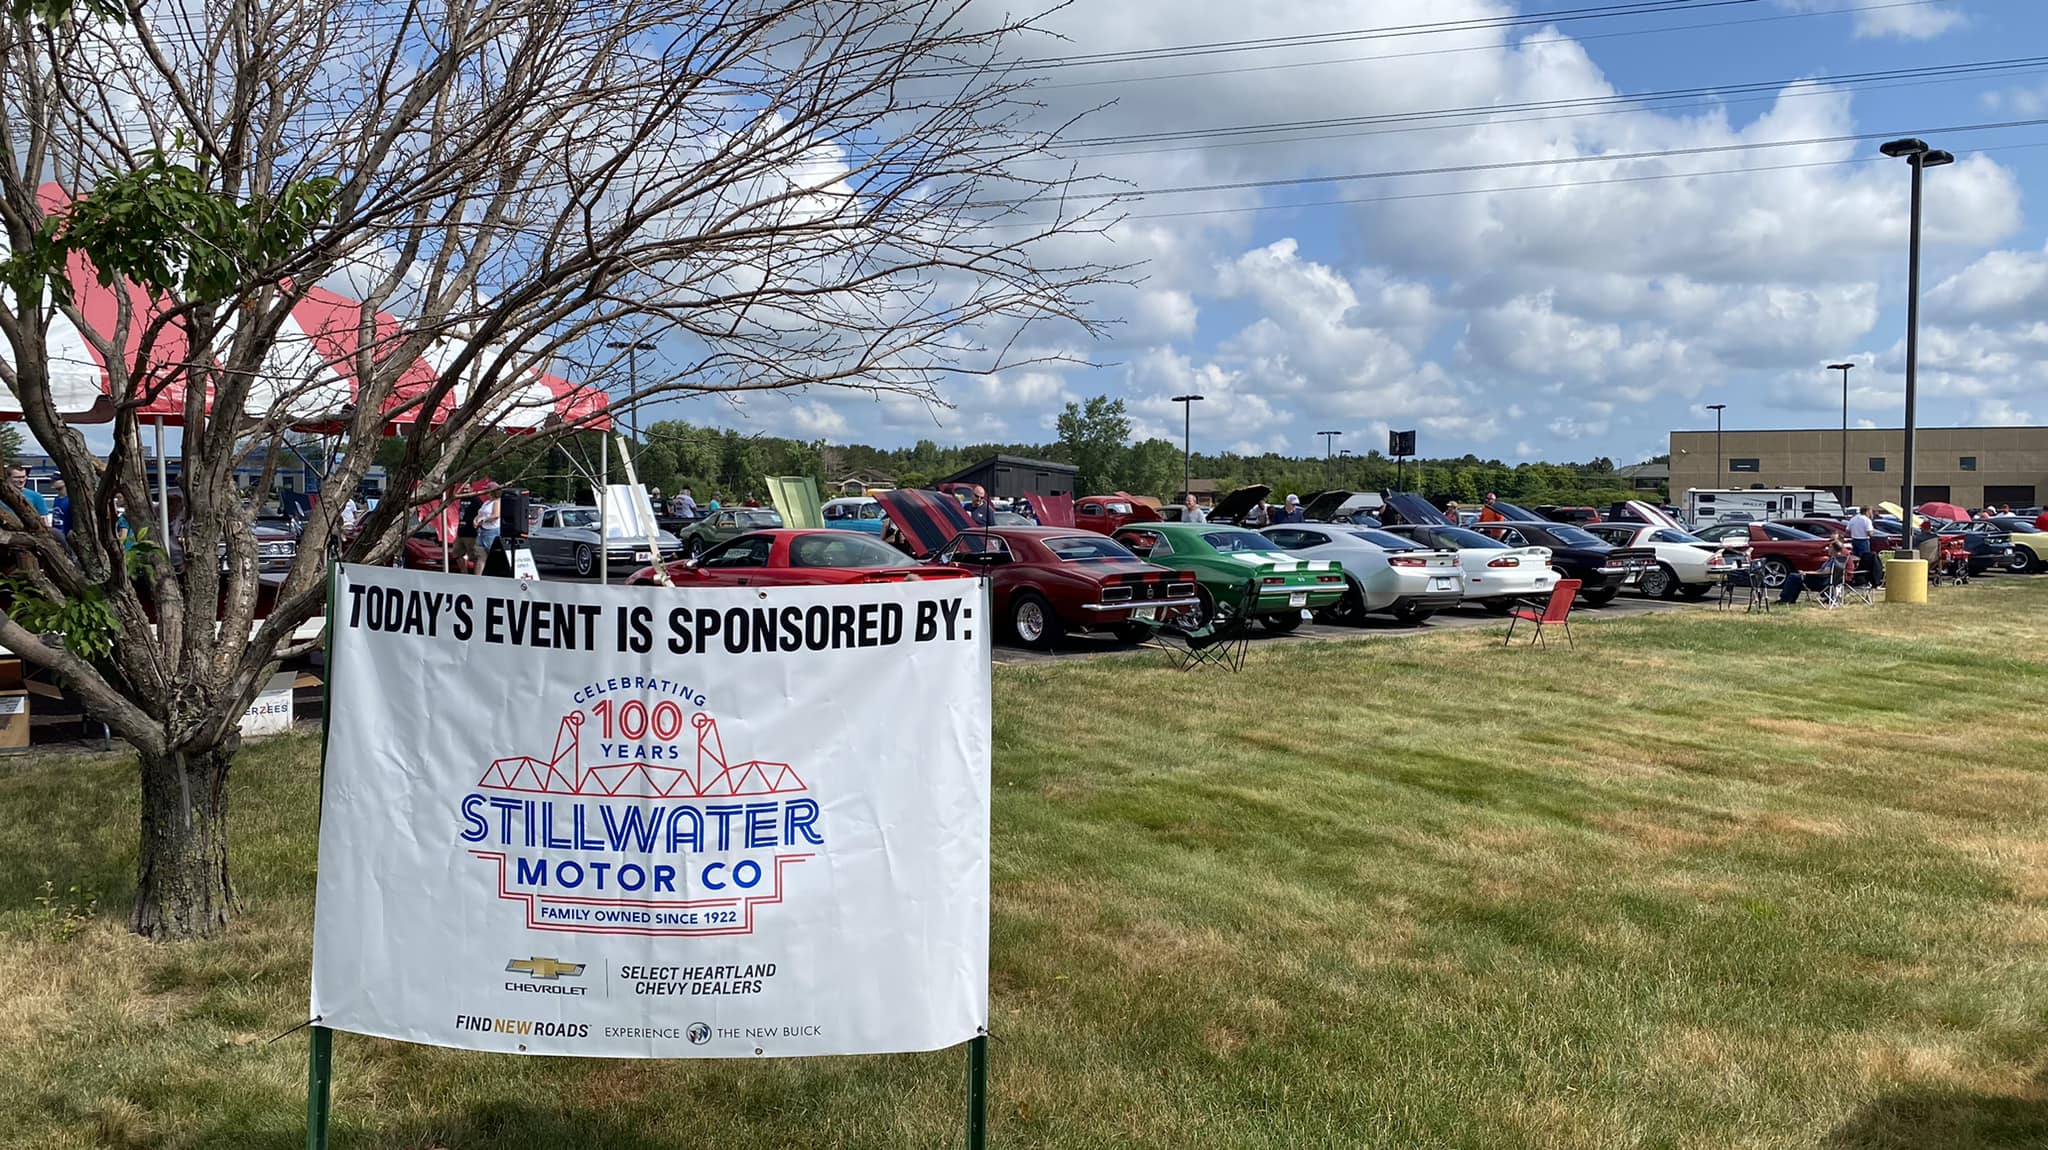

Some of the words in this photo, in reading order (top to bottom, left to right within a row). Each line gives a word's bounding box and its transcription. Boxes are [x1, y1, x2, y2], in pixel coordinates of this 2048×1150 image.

[348, 583, 474, 642] TODAY'S
[484, 596, 602, 653] EVENT
[616, 605, 654, 655] IS
[667, 602, 904, 656] SPONSORED
[914, 597, 974, 643] BY:
[573, 676, 706, 708] CELEBRATING
[591, 699, 683, 742] 100
[600, 743, 679, 760] YEARS
[460, 793, 825, 854] STILLWATER
[517, 857, 677, 893] MOTOR
[701, 859, 762, 890] CO
[540, 906, 591, 923] FAMILY
[594, 910, 651, 924] OWNED
[655, 912, 699, 925] SINCE
[703, 911, 737, 925] 1922
[620, 965, 681, 981] SELECT
[682, 962, 777, 981] HEARTLAND
[504, 981, 589, 997] CHEVROLET
[635, 980, 689, 996] CHEVY
[691, 979, 763, 996] DEALERS
[604, 1026, 681, 1040] EXPERIENCE
[716, 1027, 741, 1040] THE
[745, 1027, 778, 1039] NEW
[783, 1024, 823, 1038] BUICK
